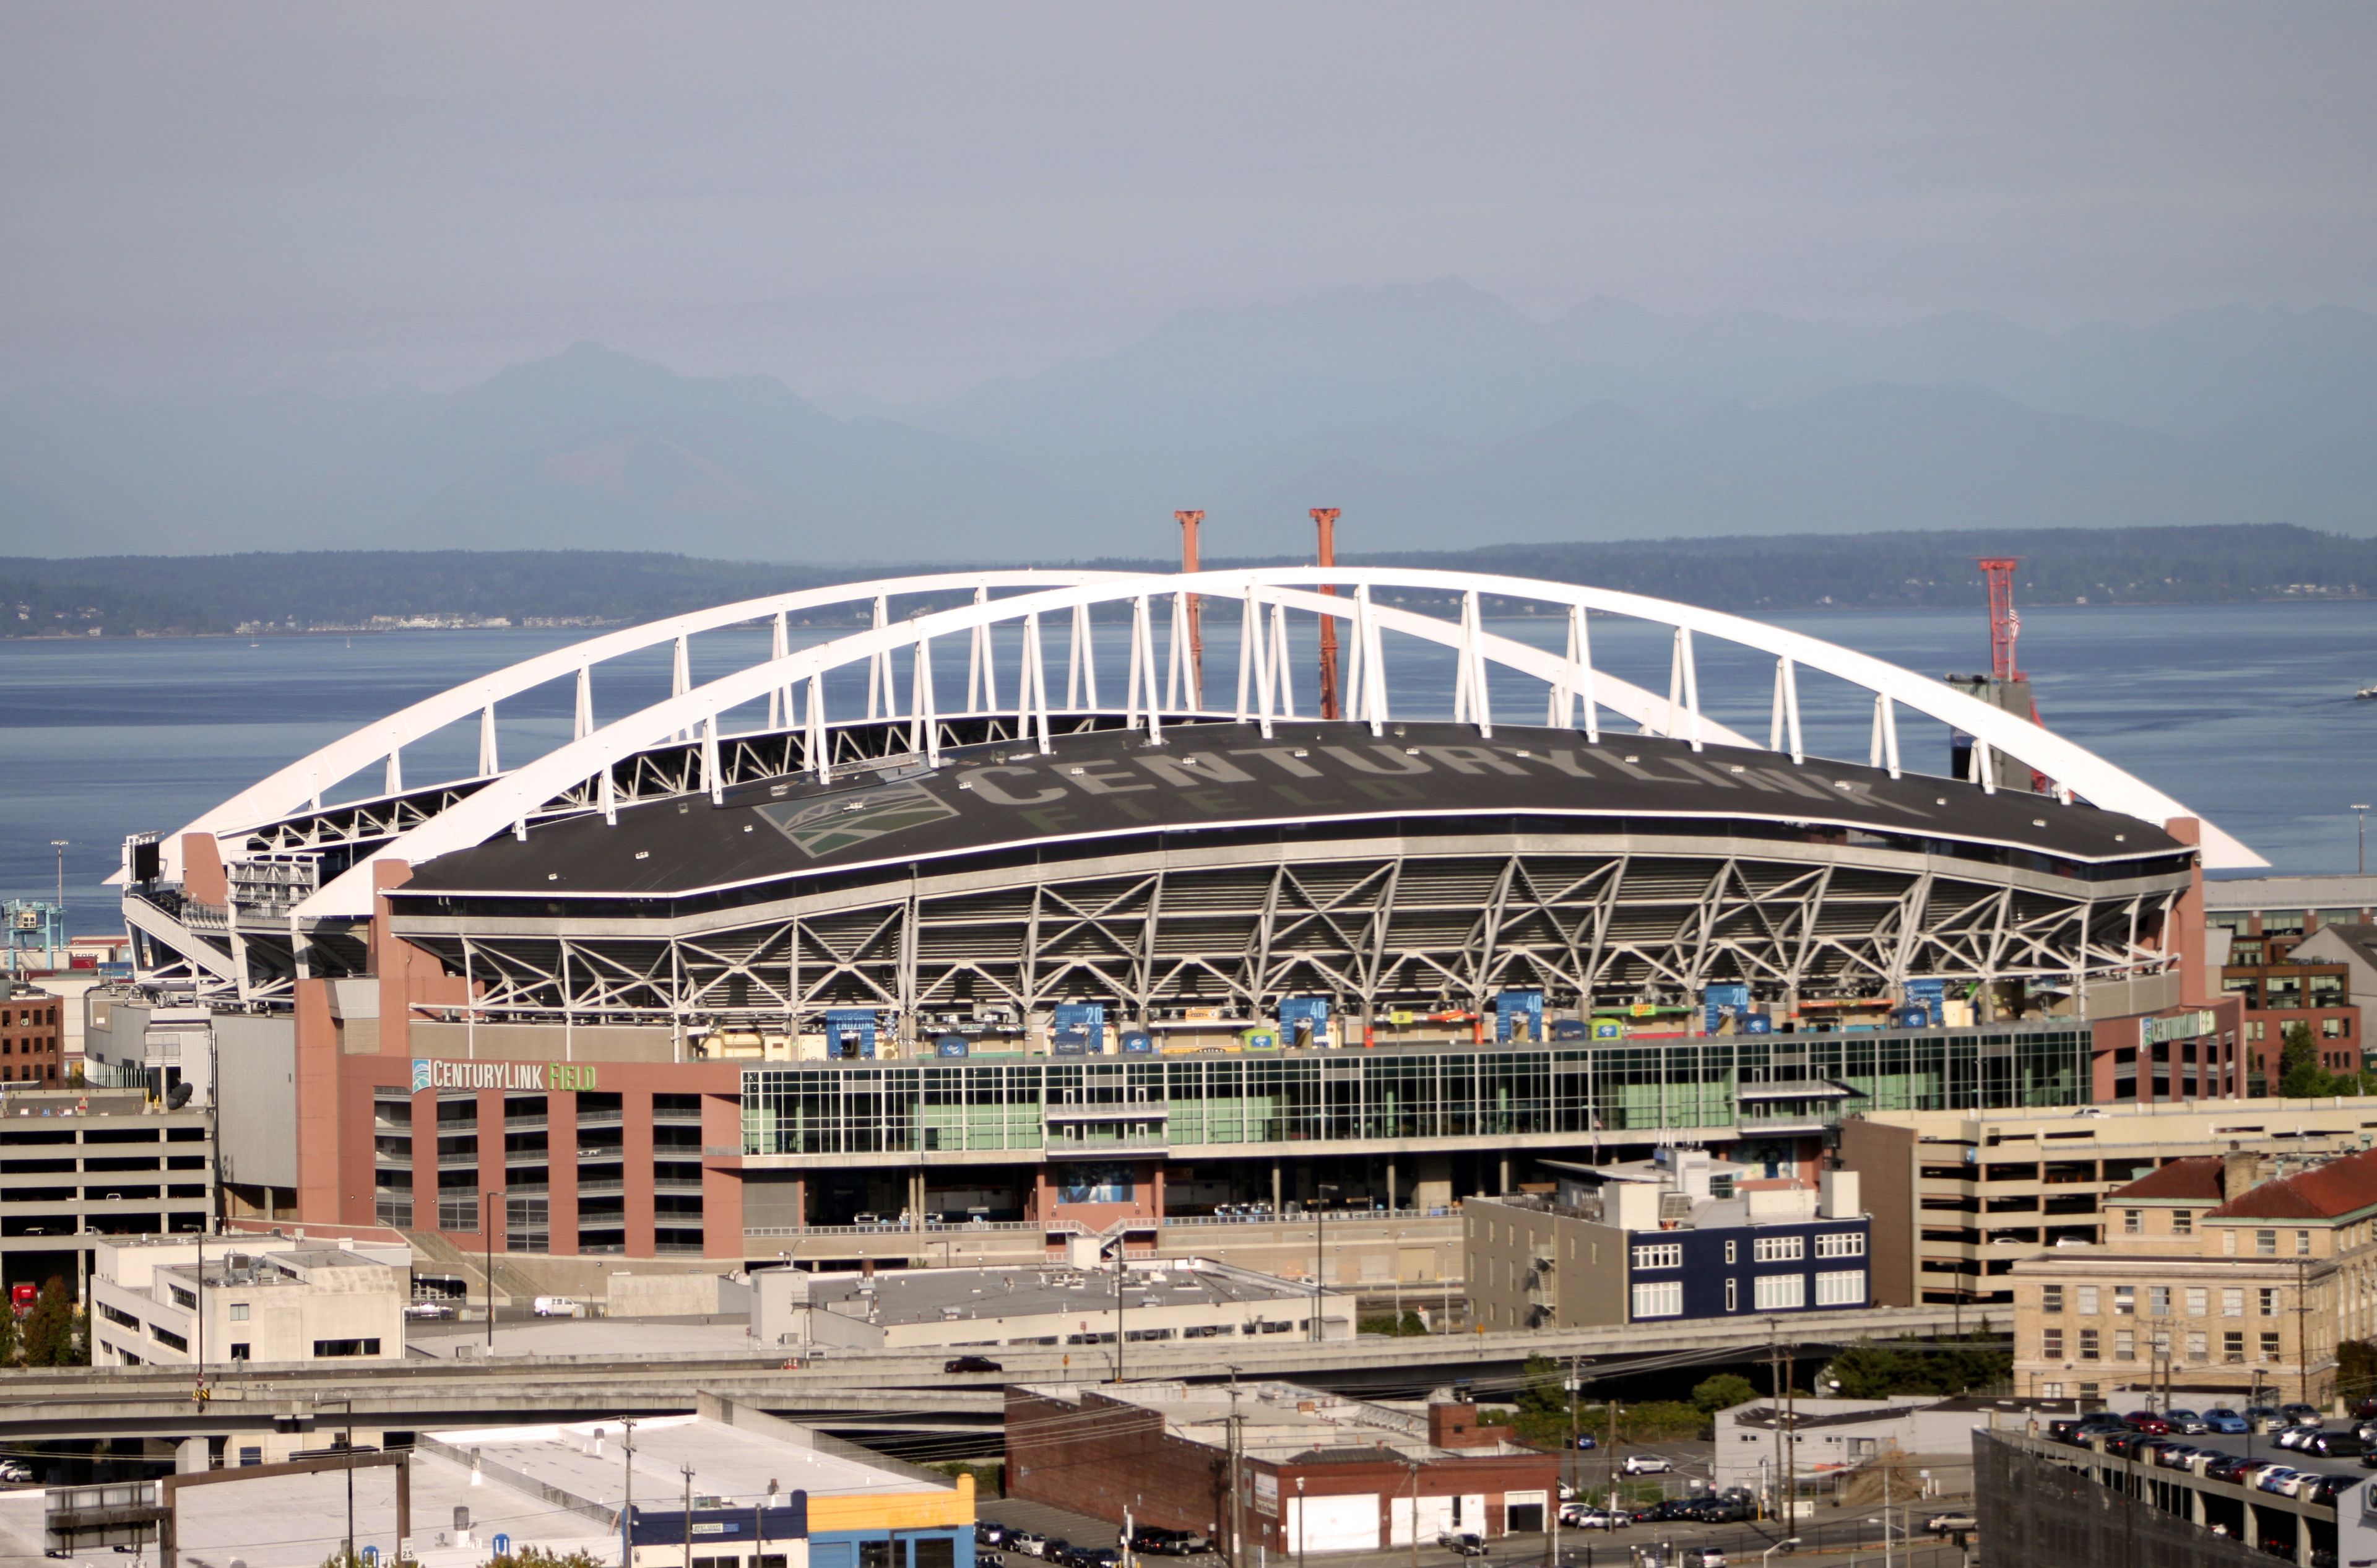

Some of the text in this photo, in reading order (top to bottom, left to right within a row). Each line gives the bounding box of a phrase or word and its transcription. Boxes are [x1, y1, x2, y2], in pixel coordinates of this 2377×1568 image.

[1018, 779, 1427, 834] FIELD
[1526, 995, 1541, 1013] 40
[1731, 988, 1747, 1005] 20
[1086, 1007, 1103, 1024] 20
[1310, 1001, 1325, 1018] 40
[433, 1060, 596, 1091] CENTURYLINK FIELD
[402, 1550, 413, 1559] 25
